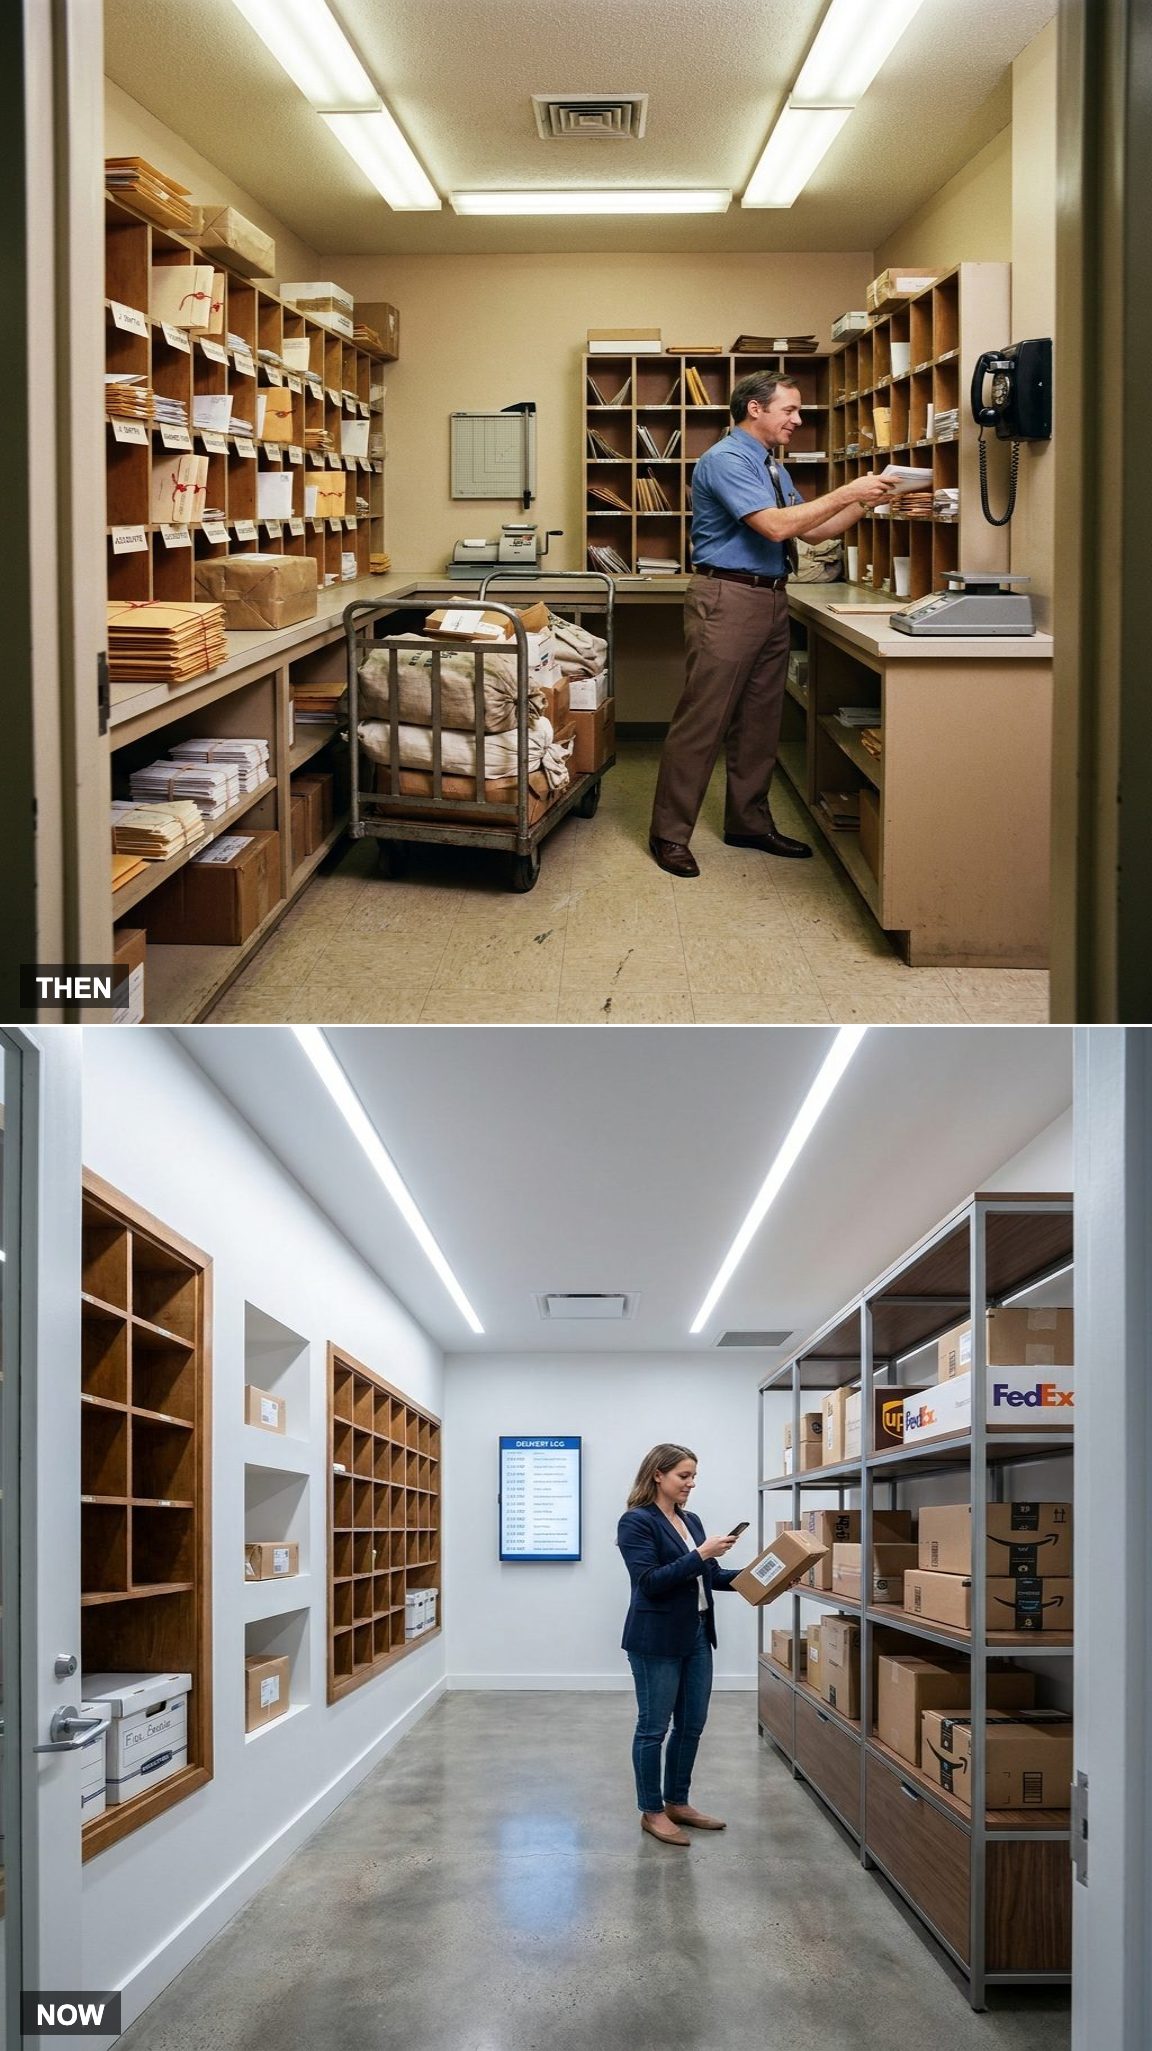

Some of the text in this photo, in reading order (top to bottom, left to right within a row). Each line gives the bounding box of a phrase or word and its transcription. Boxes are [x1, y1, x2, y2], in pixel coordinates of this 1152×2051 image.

[993, 1383, 1075, 1407] FedEx
[885, 1412, 904, 1432] up
[905, 1405, 937, 1431] FedEx
